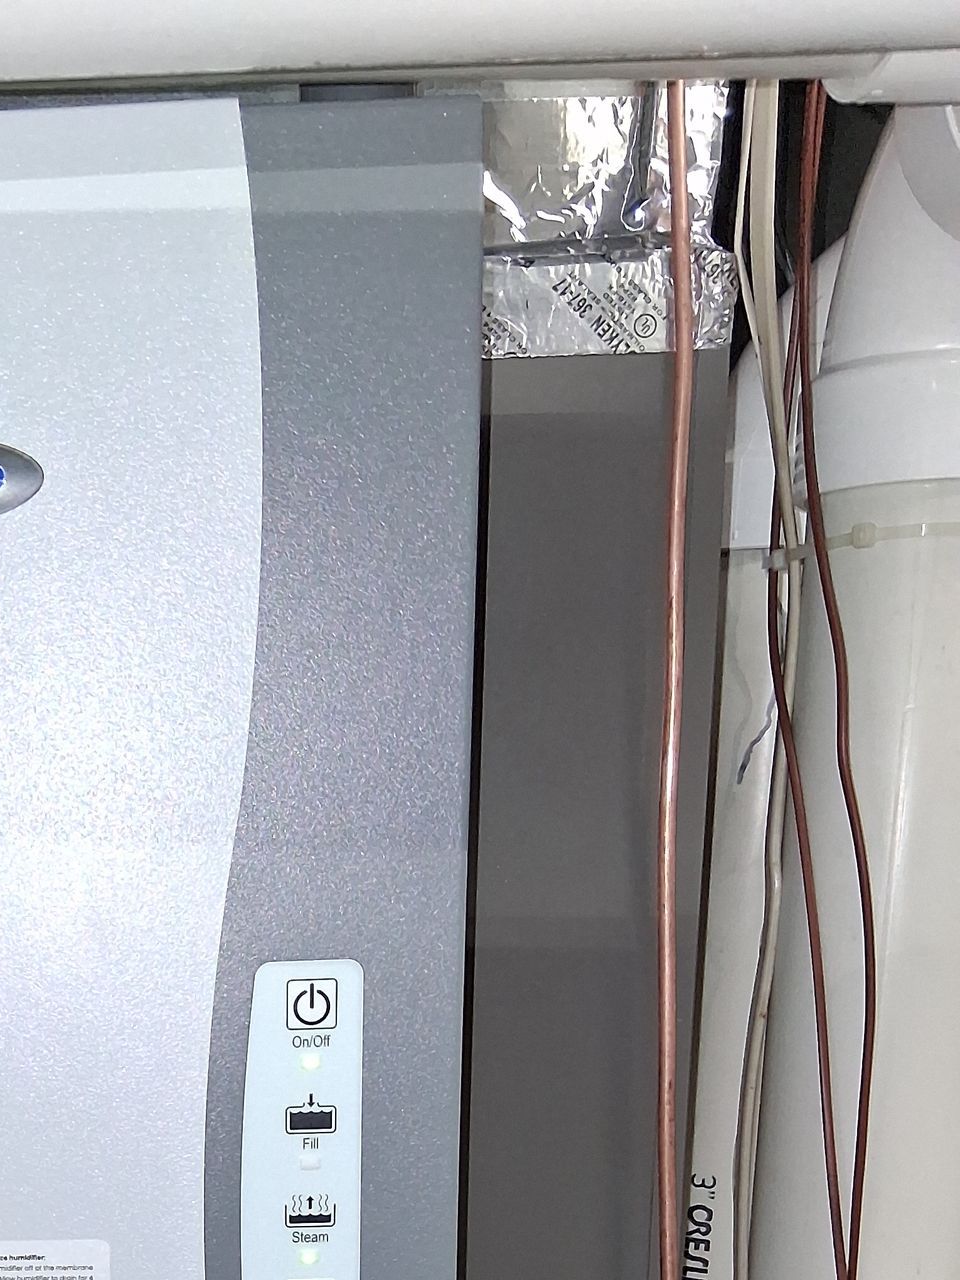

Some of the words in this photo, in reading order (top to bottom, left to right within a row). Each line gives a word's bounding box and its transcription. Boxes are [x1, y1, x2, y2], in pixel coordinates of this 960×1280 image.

[551, 277, 594, 318] 367-17
[626, 279, 652, 304] CLASS
[292, 1035, 331, 1049] On/Off
[302, 1137, 320, 1150] Fill
[291, 1231, 329, 1244] Steam
